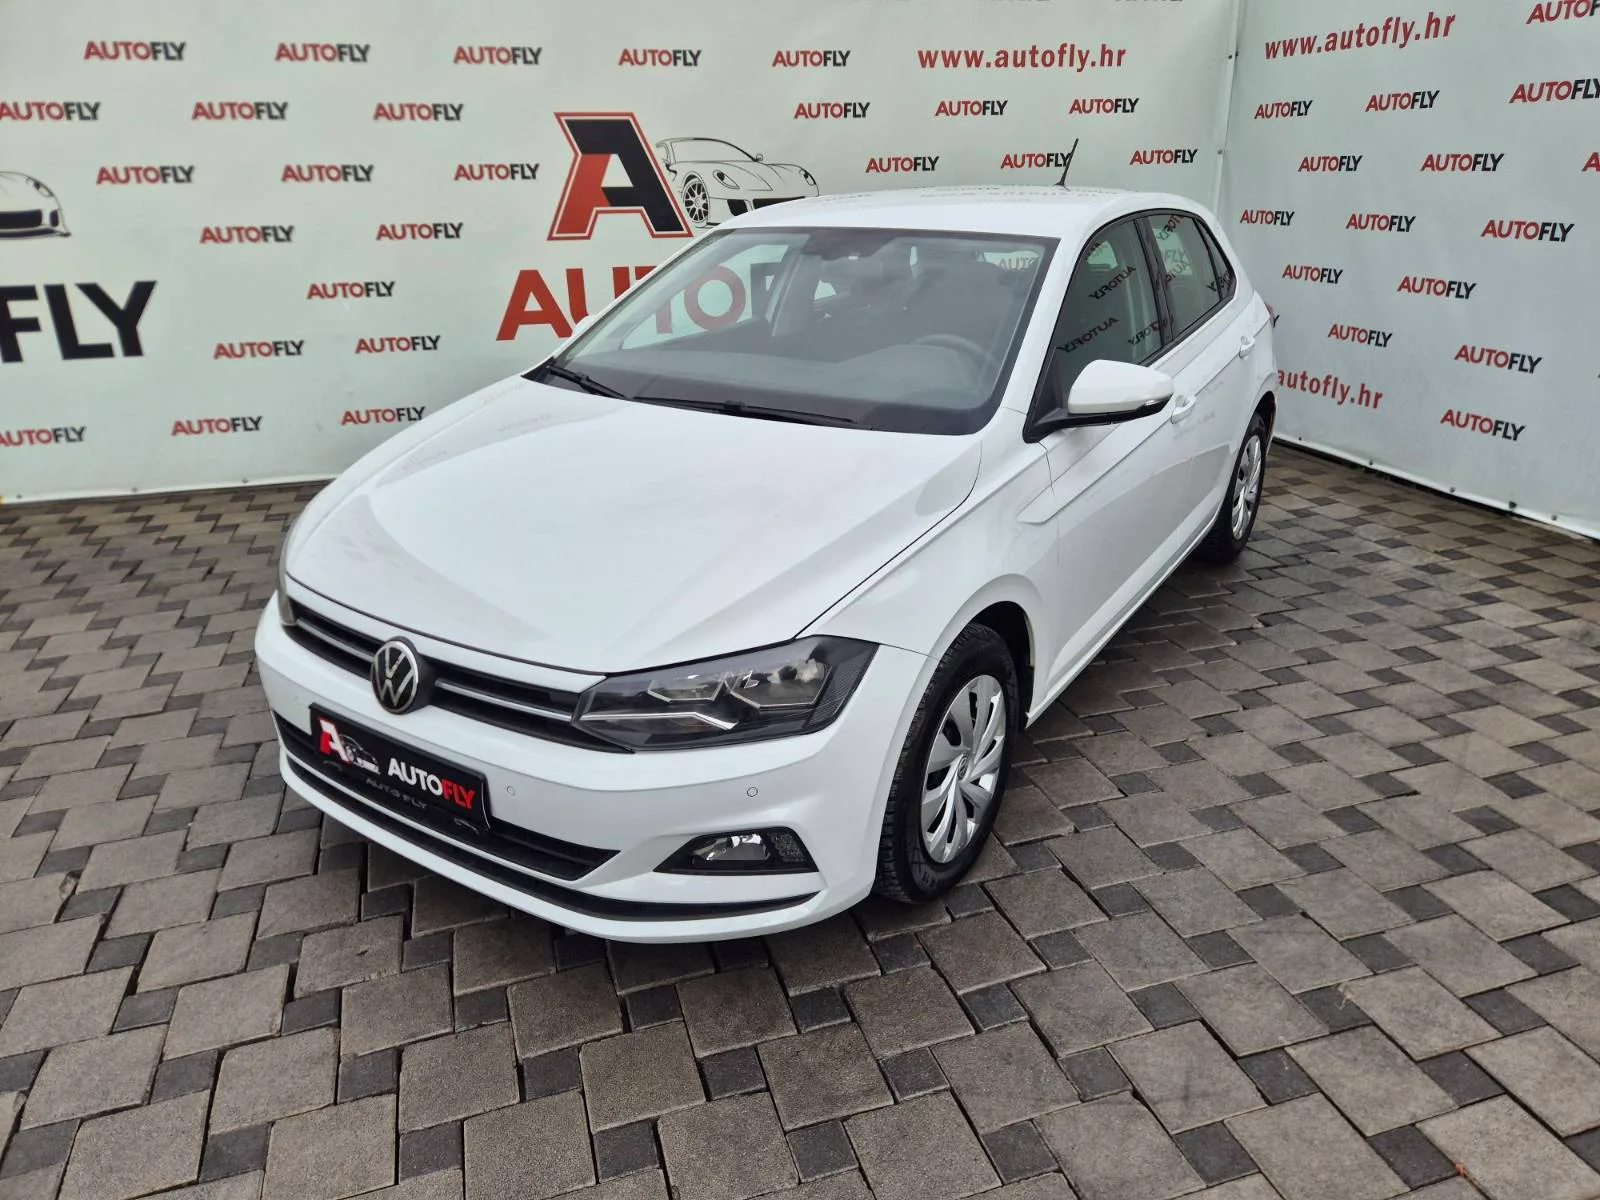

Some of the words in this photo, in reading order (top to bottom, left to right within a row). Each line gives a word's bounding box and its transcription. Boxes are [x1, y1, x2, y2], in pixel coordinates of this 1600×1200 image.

[1265, 12, 1456, 60] www.autofly.hr
[84, 41, 186, 61] AUTOFLY
[275, 43, 370, 63] AUTOFLY
[453, 46, 542, 65] AUTOFLY
[618, 49, 702, 66] AUTOFLY
[772, 50, 851, 67] AUTOFLY
[918, 43, 1126, 73] www.autofly.hr
[794, 102, 870, 119] AUTOFLY
[934, 100, 1008, 116] AUTOFLY
[1069, 98, 1139, 114] AUTOFLY
[1254, 100, 1313, 119] AUTOFLY
[1365, 90, 1440, 112] AUTOFLY
[0, 102, 101, 121] AUTOFLY
[192, 102, 288, 120] AUTOFLY
[373, 103, 464, 121] AUTOFLY
[865, 156, 939, 173] AUTOFLY
[1000, 152, 1071, 169] AUTOFLY
[1129, 149, 1198, 165] AUTOFLY
[1298, 155, 1363, 172] AUTOFLY
[1420, 153, 1504, 172] AUTOFLY
[96, 165, 195, 184] AUTOFLY
[281, 164, 374, 182] AUTOFLY
[454, 163, 540, 181] AUTOFLY
[1240, 210, 1295, 226] AUTOFLY
[1346, 214, 1416, 232] AUTOFLY
[200, 225, 295, 244] AUTOFLY
[376, 222, 463, 241] AUTOFLY
[1480, 220, 1575, 242] AUTOFLY
[1282, 264, 1343, 284] AUTOFLY
[307, 281, 395, 300] AUTOFLY
[1397, 276, 1477, 299] AUTOFLY
[0, 280, 157, 363] FLY
[355, 335, 441, 354] AUTOFLY
[1328, 324, 1392, 348] AUTOFLY
[213, 340, 305, 359] AUTOFLY
[1454, 345, 1542, 374] AUTOFLY
[341, 406, 426, 426] AUTOFLY
[1440, 409, 1525, 441] AUTOFLY
[171, 416, 262, 436] AUTOFLY
[388, 757, 476, 810] AUTOFLY
